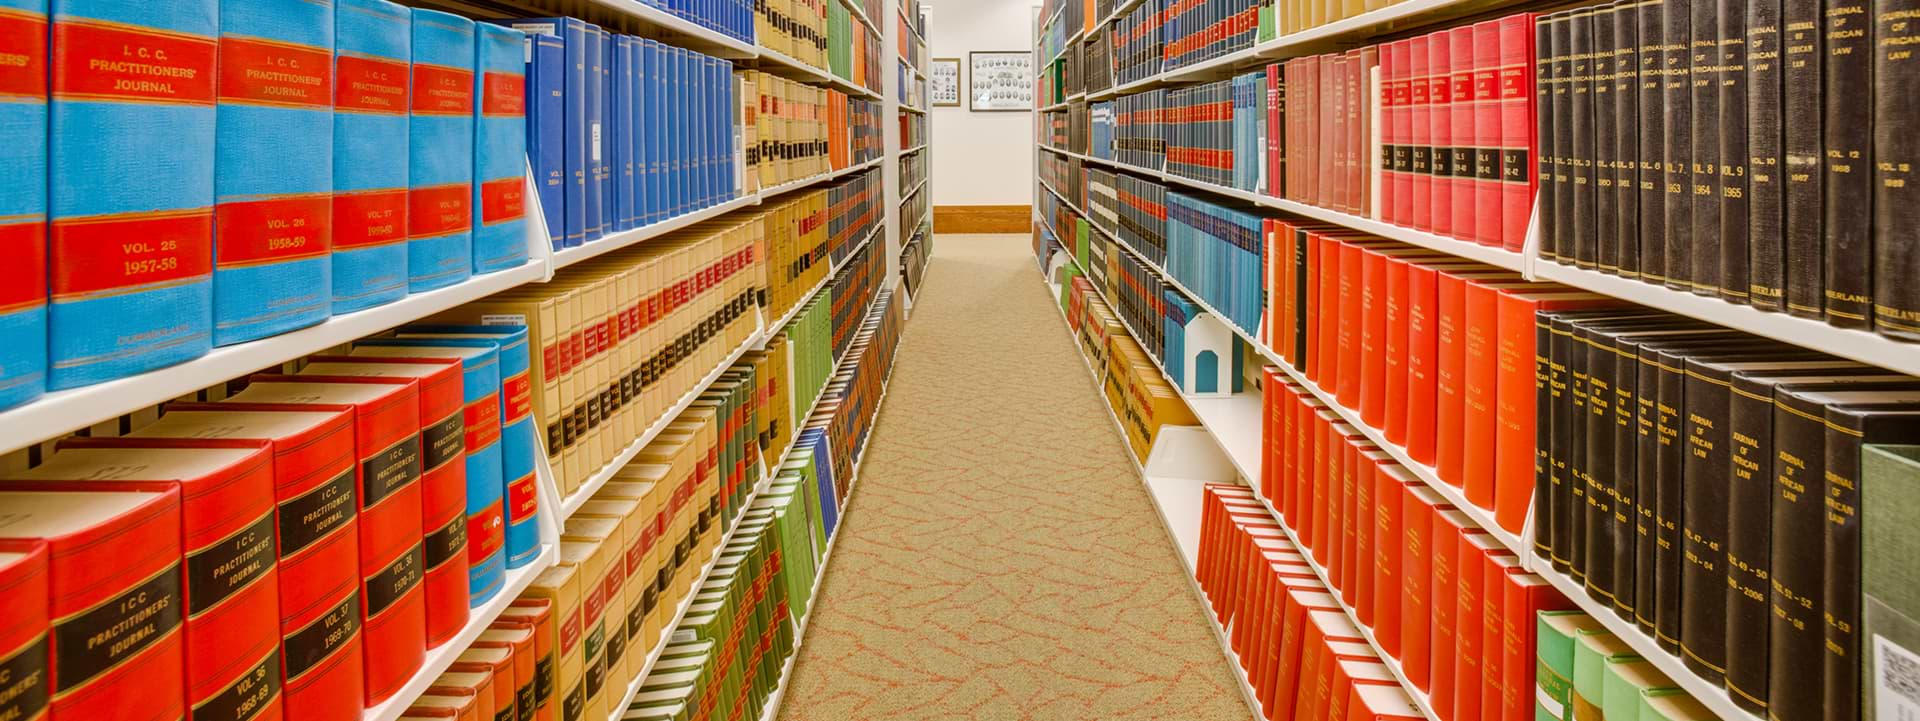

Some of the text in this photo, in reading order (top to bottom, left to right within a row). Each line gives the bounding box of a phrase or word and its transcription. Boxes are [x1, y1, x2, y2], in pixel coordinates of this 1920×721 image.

[1827, 6, 1864, 16] OURNAL
[1881, 10, 1920, 21] OURNAL
[1834, 18, 1846, 27] OF
[1892, 23, 1907, 32] OF
[1828, 30, 1863, 40] FRICAN
[123, 45, 168, 60] I. C. C.
[1748, 52, 1778, 60] FRICAN
[1832, 47, 1852, 55] LAW
[1888, 51, 1911, 60] LAW
[278, 58, 287, 66] C.
[291, 60, 300, 68] C.
[1753, 64, 1769, 72] LAW
[90, 59, 197, 79] PRACTITIONERS'
[113, 79, 174, 94] JOURNAL
[264, 86, 307, 97] JOURNAL
[1878, 163, 1896, 171] VOL.
[1640, 182, 1653, 190] 962
[1668, 184, 1681, 193] 963
[1694, 185, 1710, 195] 1964
[1723, 187, 1742, 197] 1965
[268, 218, 305, 229] VOL. 26
[124, 240, 177, 255] VOL. 25
[269, 236, 306, 250] 1958-59
[124, 257, 177, 276] 1957-58
[1690, 413, 1713, 429] JOURNAL
[1696, 427, 1704, 435] OF
[1690, 435, 1713, 450] AFRICAN
[1733, 432, 1759, 448] JOURNAL
[1694, 448, 1707, 458] LAW
[1740, 446, 1747, 455] OF
[1733, 454, 1759, 471] AFRICAN
[1779, 451, 1806, 469] JOURNAL
[1737, 469, 1750, 480] LAW
[1786, 466, 1793, 476] OF
[385, 471, 407, 488] JOURNAL
[1779, 475, 1805, 493] AFRICAN
[1783, 489, 1796, 502] LAW
[1832, 487, 1841, 496] OF
[304, 490, 351, 524] PRACTITIONERS'
[1644, 509, 1651, 517] 45
[1828, 512, 1845, 525] LAW
[316, 511, 343, 533] JOURNAL
[1709, 541, 1719, 551] 48
[213, 536, 270, 579] PRACTITIONERS'
[393, 562, 404, 574] VOL.
[1703, 561, 1713, 570] 04
[1738, 561, 1767, 579] 49 50
[228, 560, 260, 587] JOURNAL
[1744, 587, 1763, 601] 2006
[1800, 598, 1813, 609] 52
[88, 594, 171, 650] PRACTITIONERS'
[324, 604, 349, 629] VOL. 37
[1838, 621, 1850, 632] 53
[110, 623, 156, 657] JOURNAL
[324, 620, 352, 649] 1969-70
[237, 665, 266, 696] VOL. 36
[236, 684, 268, 720] 1968-69
